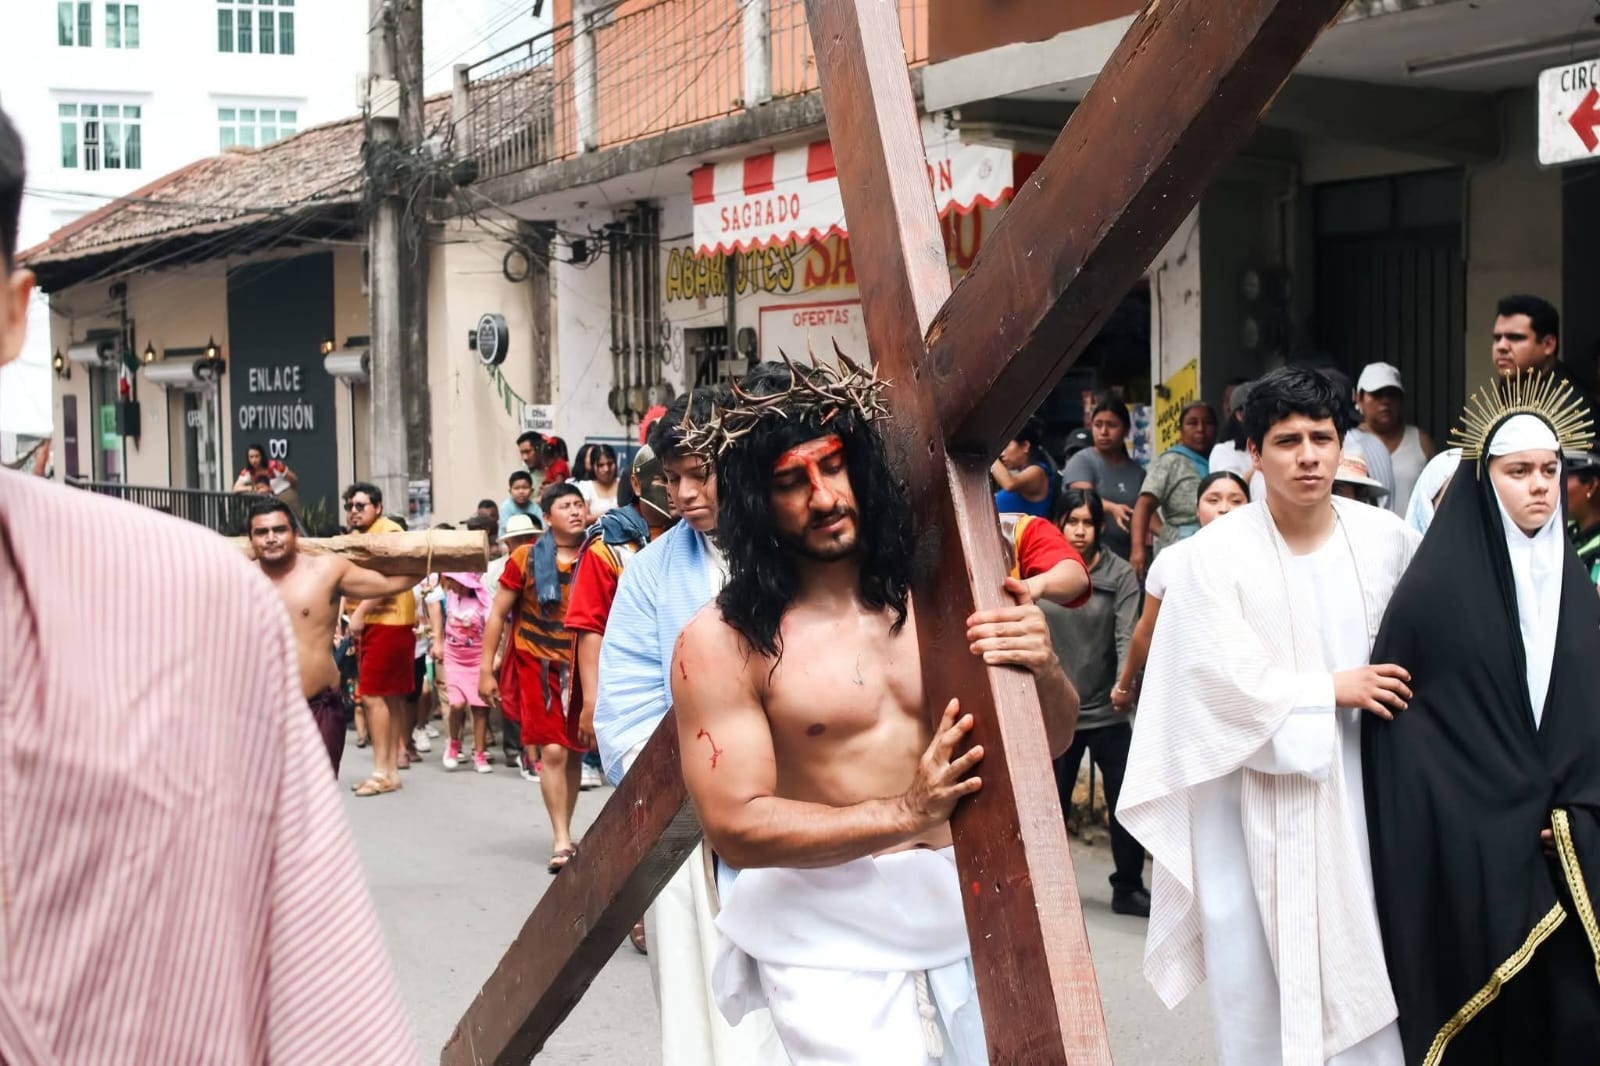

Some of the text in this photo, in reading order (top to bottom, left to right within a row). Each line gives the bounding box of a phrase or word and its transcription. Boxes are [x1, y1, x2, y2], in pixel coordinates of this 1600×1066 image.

[720, 194, 800, 233] SAGRADO
[666, 238, 797, 303] ABAROTES
[793, 310, 849, 327] OFERTAS
[249, 366, 300, 392] ENLACE
[239, 397, 314, 430] OPTIVISIÓN
